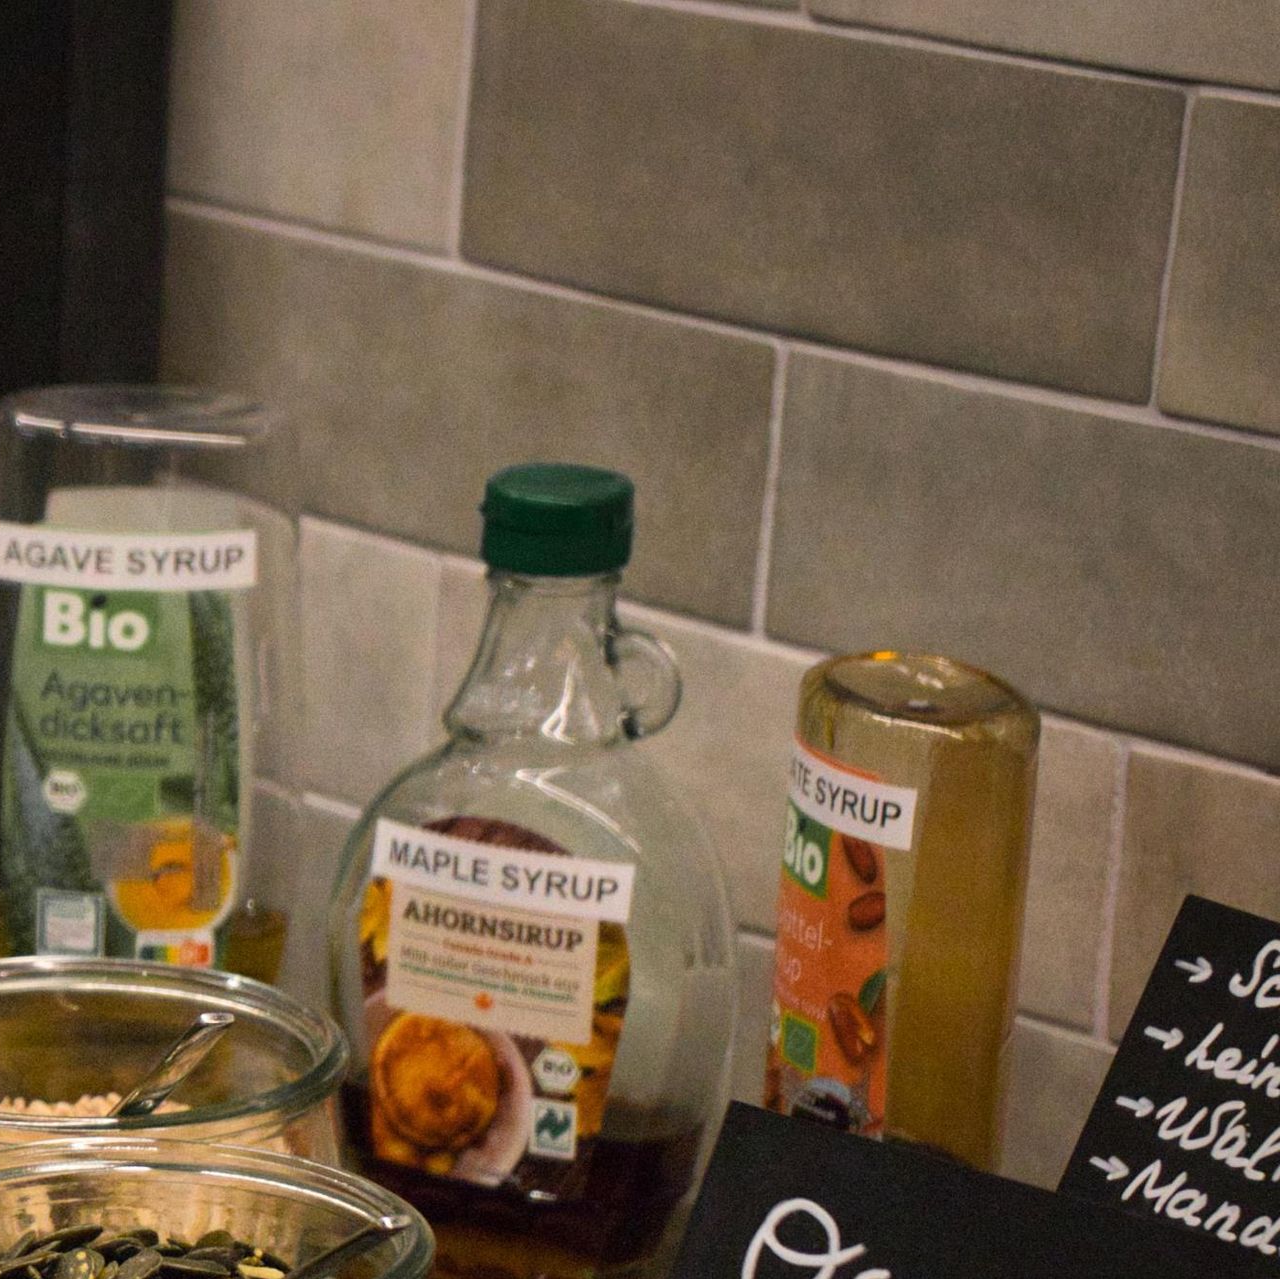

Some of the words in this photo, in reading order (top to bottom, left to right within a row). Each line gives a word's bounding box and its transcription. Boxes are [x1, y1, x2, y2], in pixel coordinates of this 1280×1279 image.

[4, 539, 115, 575] AGAVE
[126, 546, 246, 575] SYRUP
[44, 591, 150, 651] Bio
[815, 778, 902, 828] SYRUP
[389, 839, 490, 886] MAPLE
[500, 866, 620, 904] SYRUP
[403, 899, 585, 953] AHORNSIRUP
